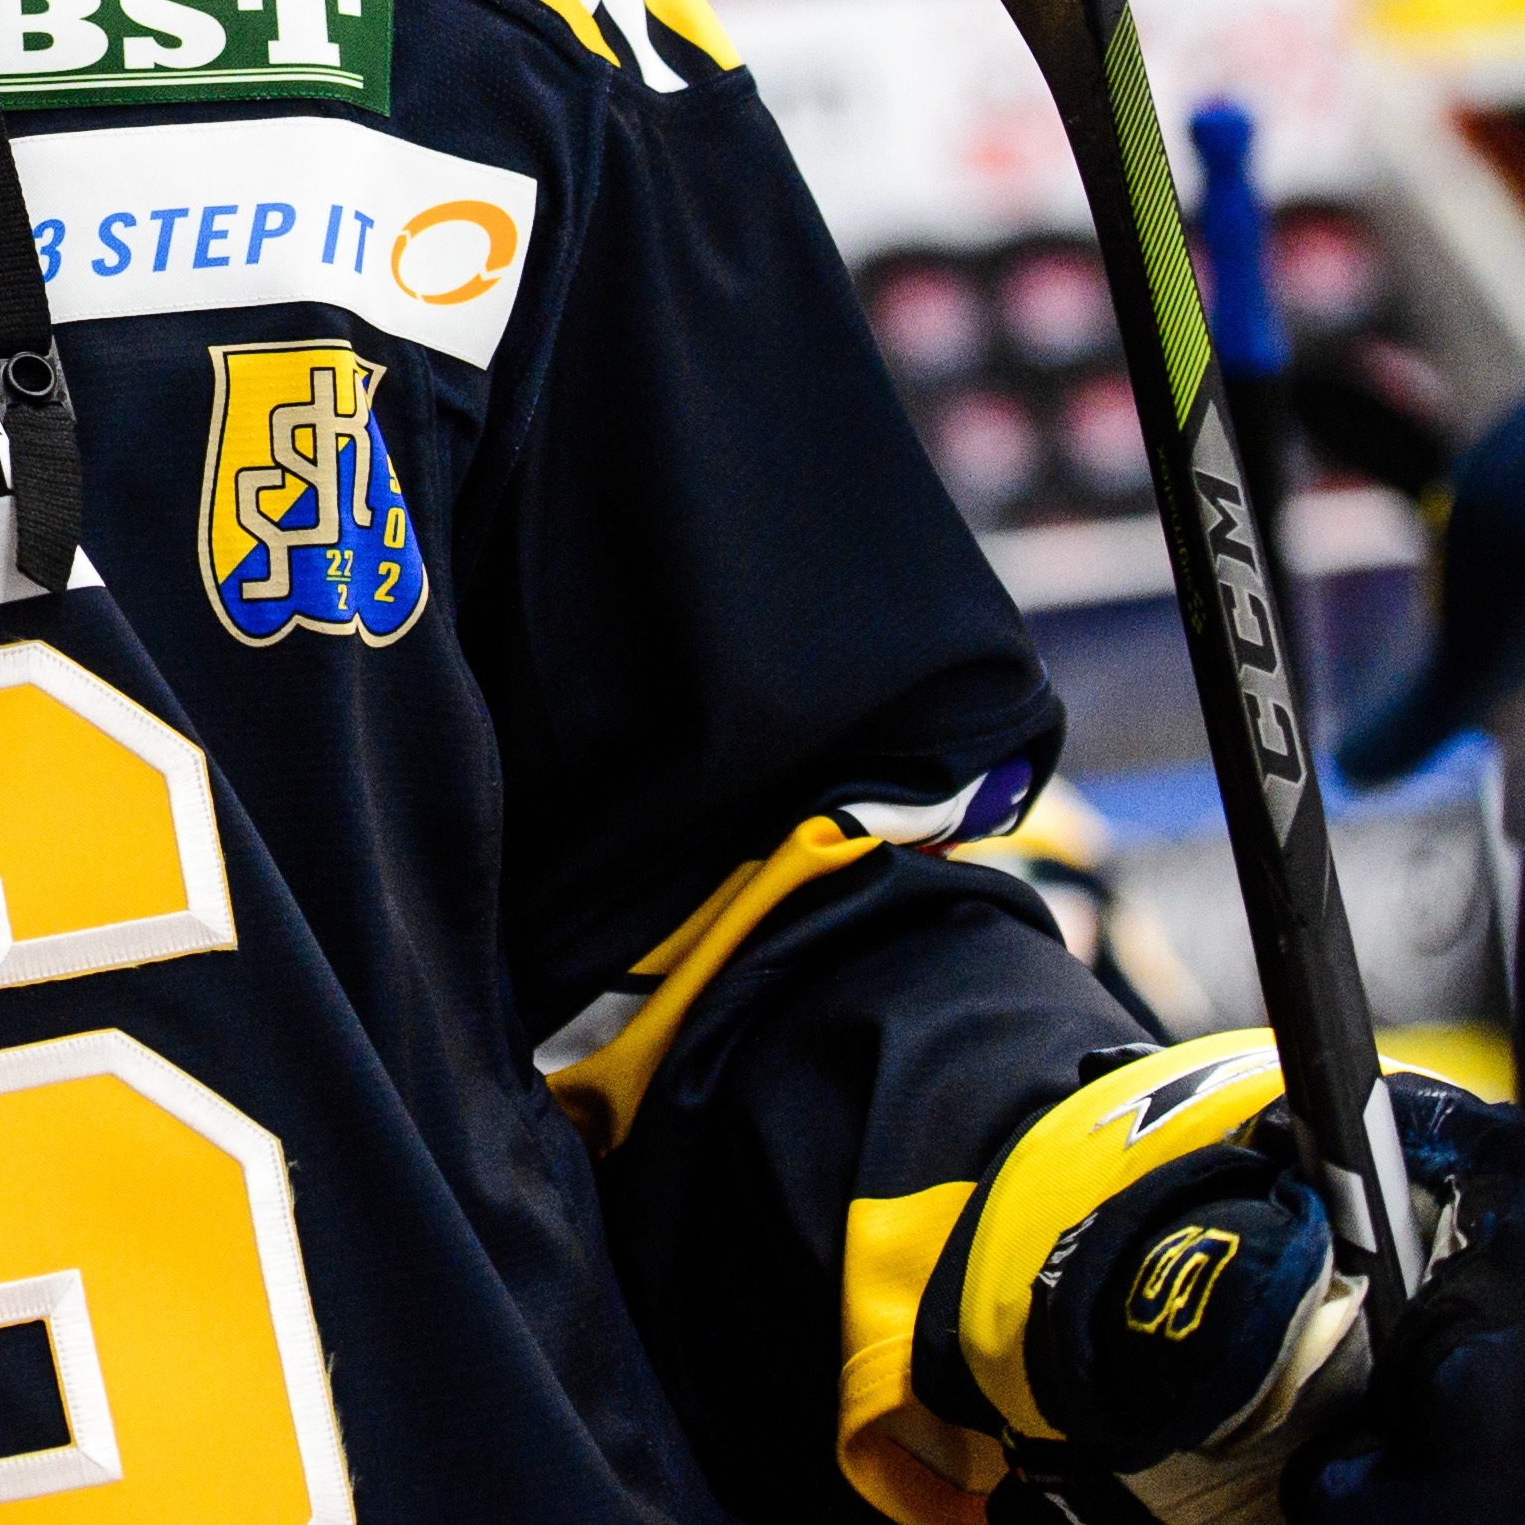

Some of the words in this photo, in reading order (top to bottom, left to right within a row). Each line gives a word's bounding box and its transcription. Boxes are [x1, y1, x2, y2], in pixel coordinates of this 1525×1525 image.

[31, 218, 67, 283] 3
[90, 201, 297, 277] STEP
[321, 204, 375, 274] IT
[1193, 469, 1308, 786] CCM
